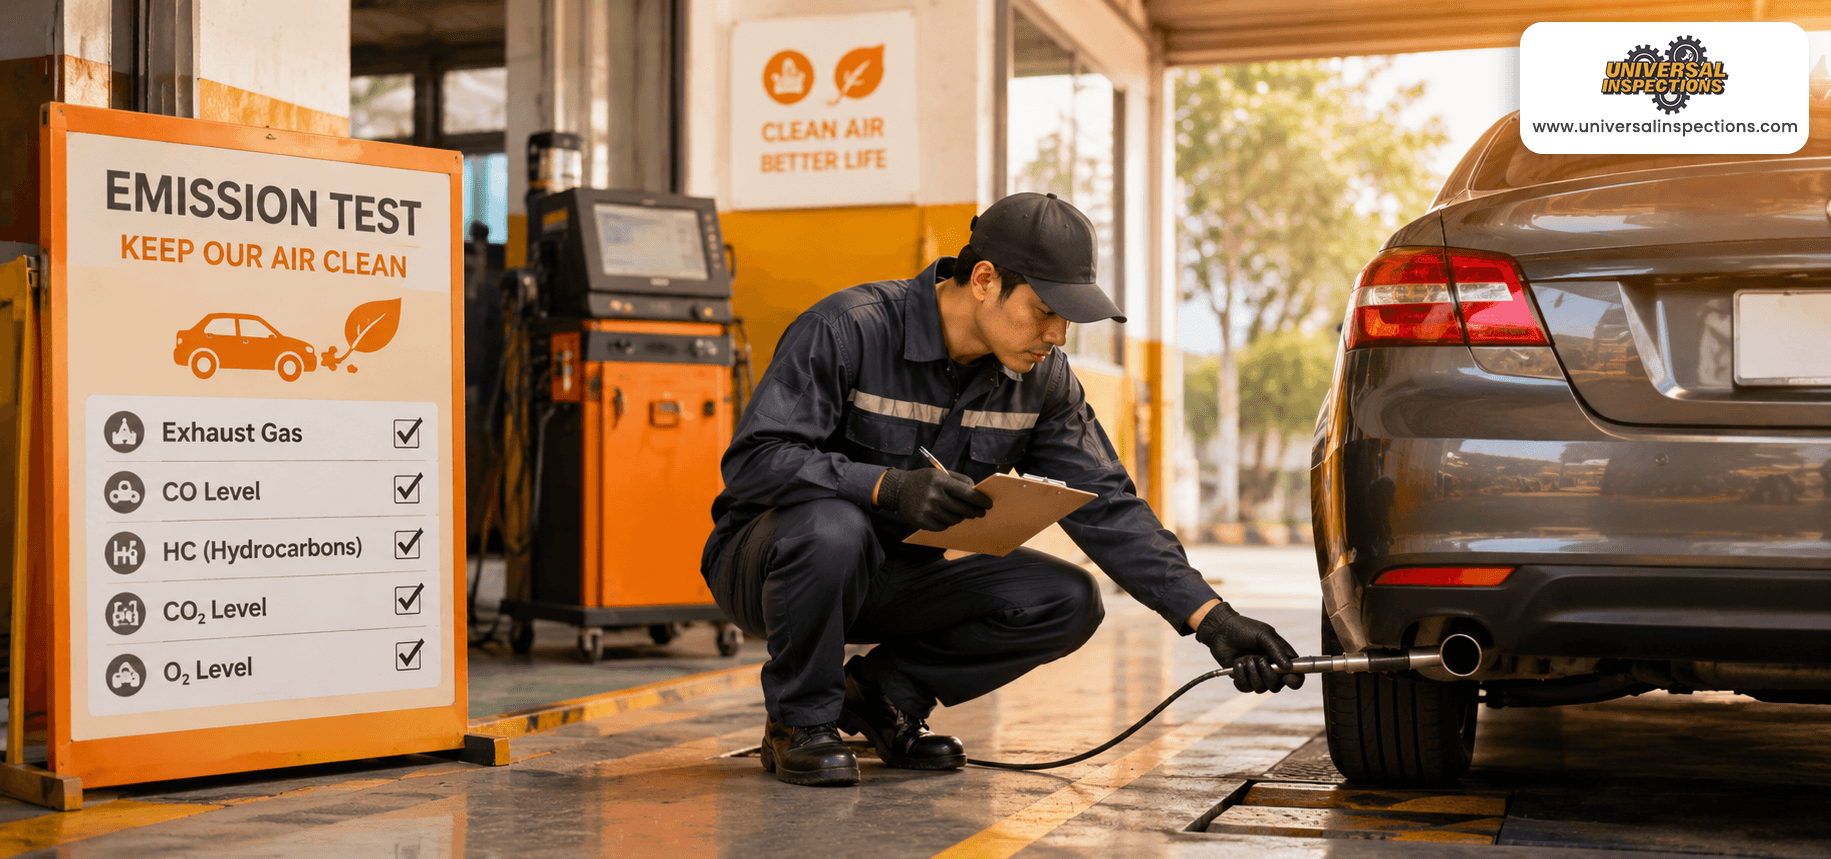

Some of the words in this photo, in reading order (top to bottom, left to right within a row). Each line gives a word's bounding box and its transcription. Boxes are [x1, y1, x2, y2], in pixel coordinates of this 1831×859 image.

[761, 120, 838, 142] CLEAN
[844, 117, 884, 138] AIR
[760, 151, 838, 173] BETTER
[845, 149, 887, 170] LIFE
[106, 170, 317, 227] EMISSION
[330, 192, 421, 236] TEST
[121, 235, 194, 263] KEEP
[203, 241, 263, 268] OUR
[271, 246, 315, 271] AIR
[323, 250, 407, 278] CLEAN
[162, 422, 255, 443] Exhaust
[261, 423, 303, 443] Gas
[162, 482, 197, 502] CO
[205, 481, 260, 501] Level
[163, 541, 197, 561] HC
[203, 536, 363, 564] (Hydrocarbons)
[211, 598, 267, 620] Level
[196, 657, 253, 680] Level
